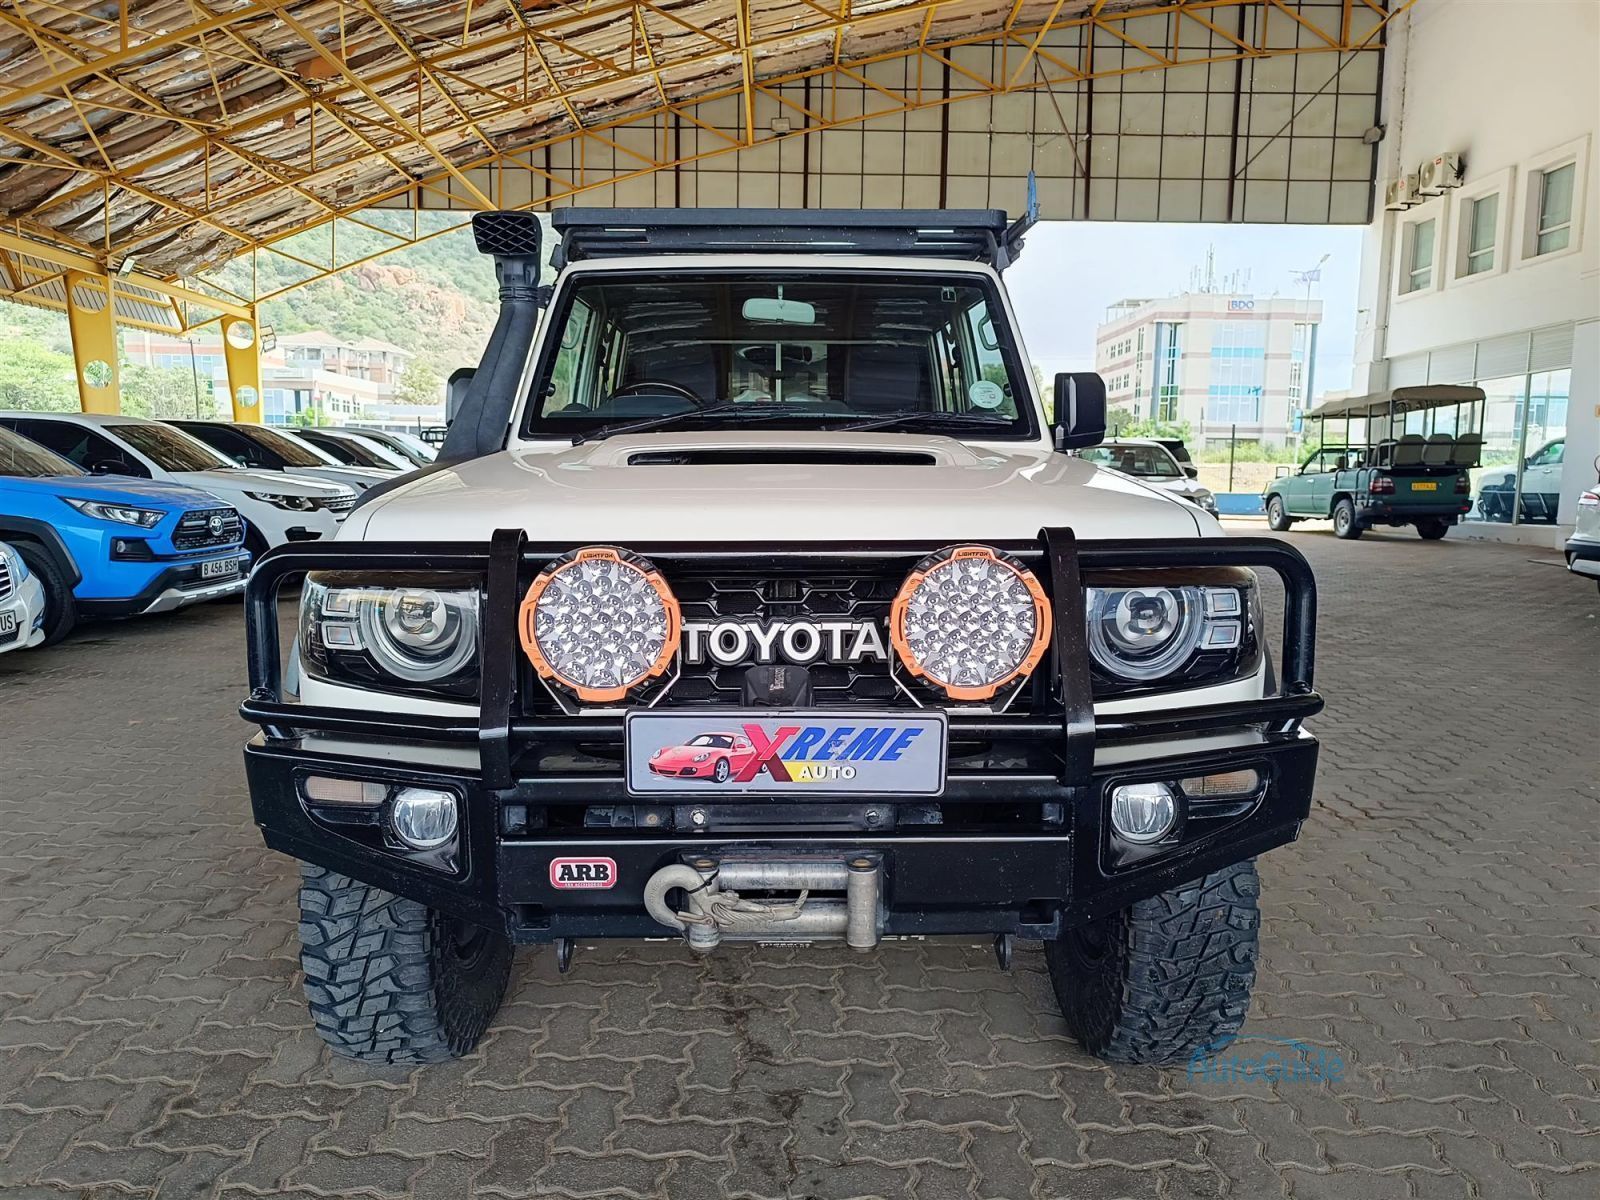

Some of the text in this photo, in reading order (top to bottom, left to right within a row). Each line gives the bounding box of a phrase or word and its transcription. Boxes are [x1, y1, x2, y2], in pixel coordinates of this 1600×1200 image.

[1231, 300, 1255, 309] BDO
[210, 561, 223, 574] 456
[224, 559, 238, 572] BSH
[681, 621, 888, 662] TOYOTA
[799, 765, 857, 780] AUTO
[558, 864, 610, 881] ARB
